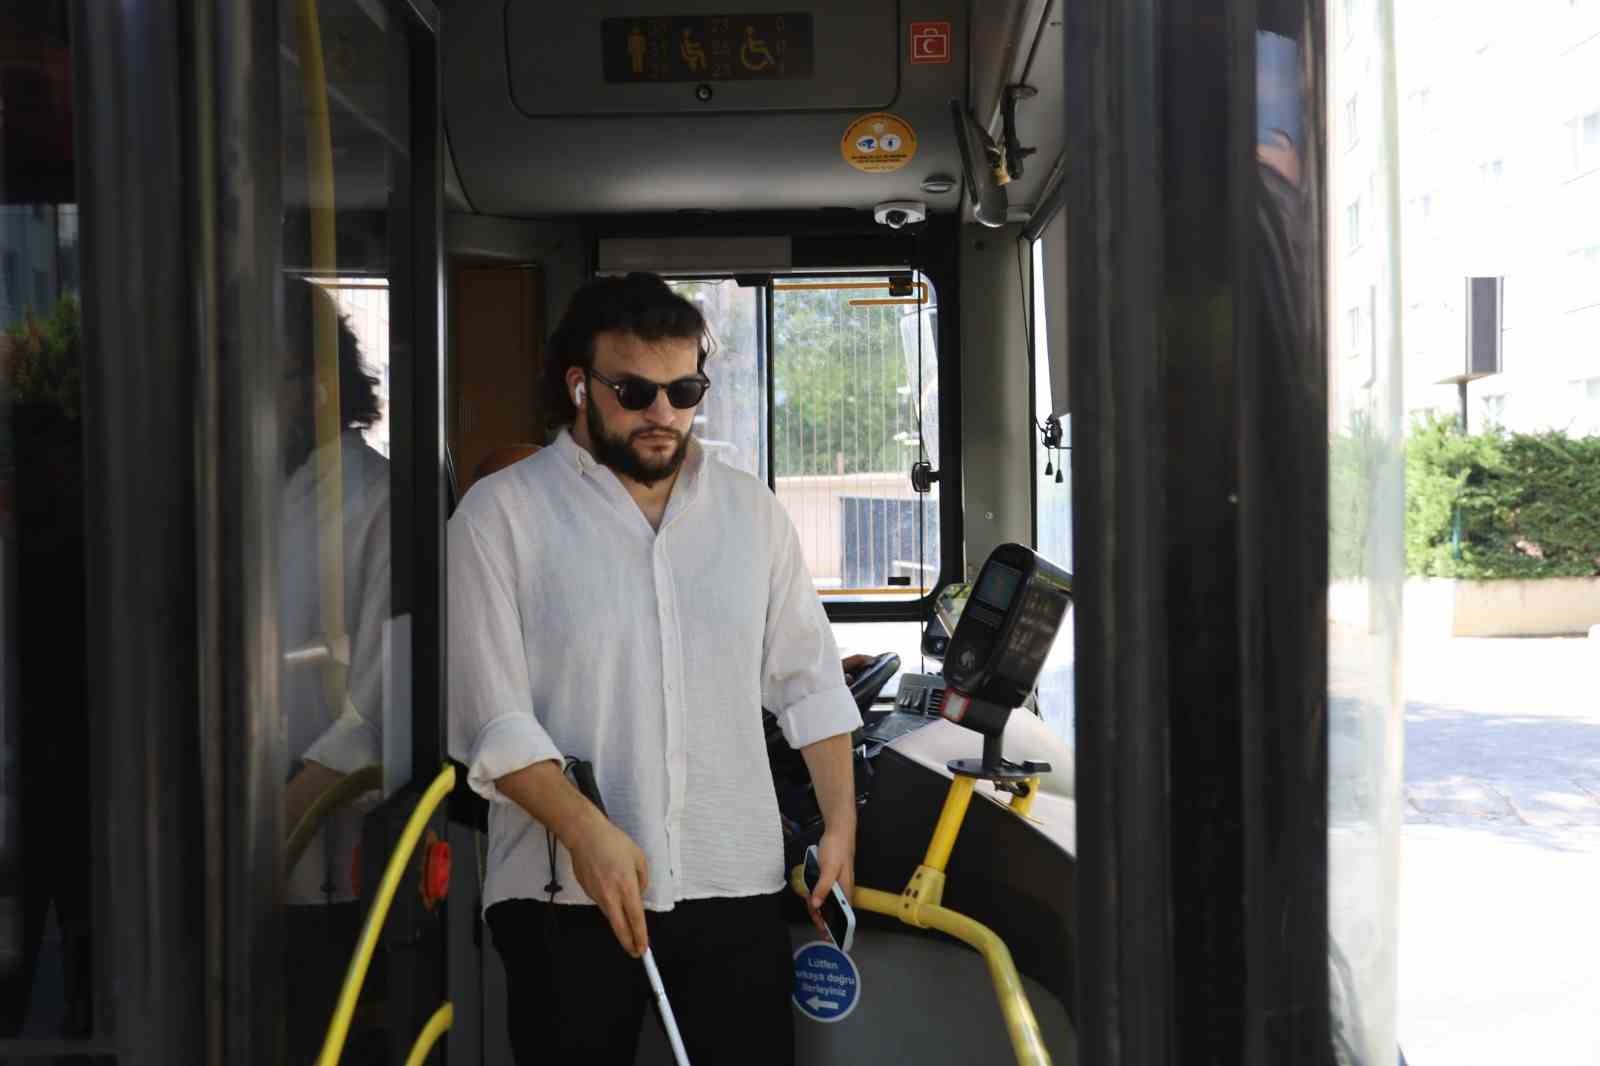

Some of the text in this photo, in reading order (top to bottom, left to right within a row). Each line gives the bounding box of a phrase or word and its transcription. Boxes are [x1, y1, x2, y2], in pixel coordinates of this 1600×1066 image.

[808, 958, 839, 969] Lütfen
[794, 970, 856, 986] rkaya doğru
